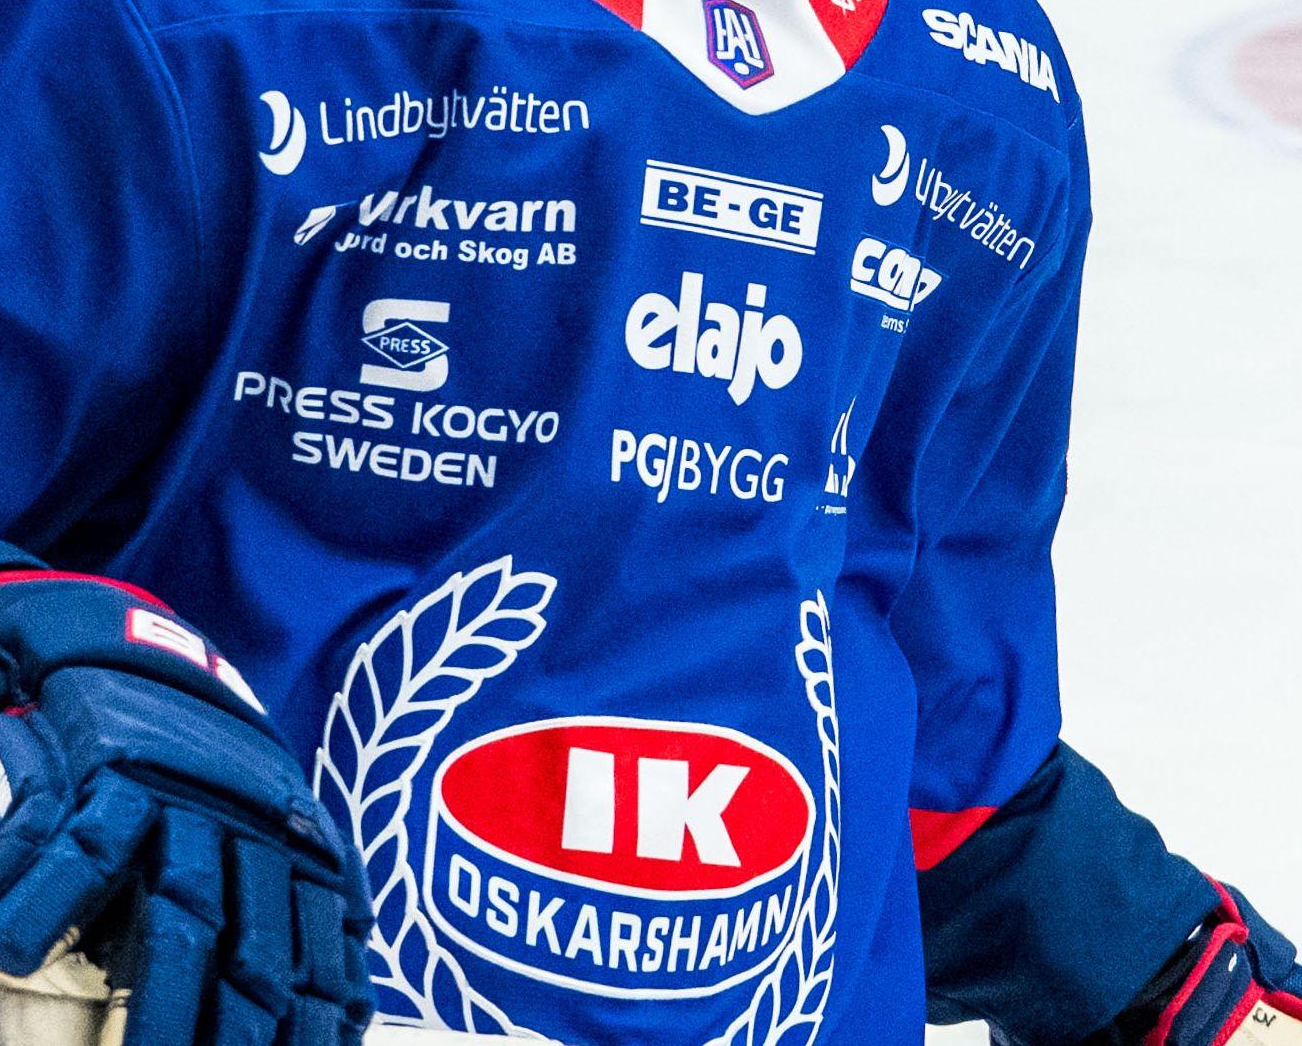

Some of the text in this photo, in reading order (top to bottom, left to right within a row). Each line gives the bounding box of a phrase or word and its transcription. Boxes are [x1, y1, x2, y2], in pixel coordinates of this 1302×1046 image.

[921, 9, 1060, 104] SCANIA
[656, 178, 805, 235] BE-GE
[395, 240, 448, 261] och
[458, 240, 529, 271] Skog
[536, 242, 577, 265] AB
[379, 336, 431, 356] PRESS
[625, 271, 803, 406] elajo
[233, 371, 560, 444] PRESS KOGYO
[292, 431, 497, 488] SWEDEN
[561, 747, 751, 868] IK
[448, 852, 792, 973] OSKARSHAMN
